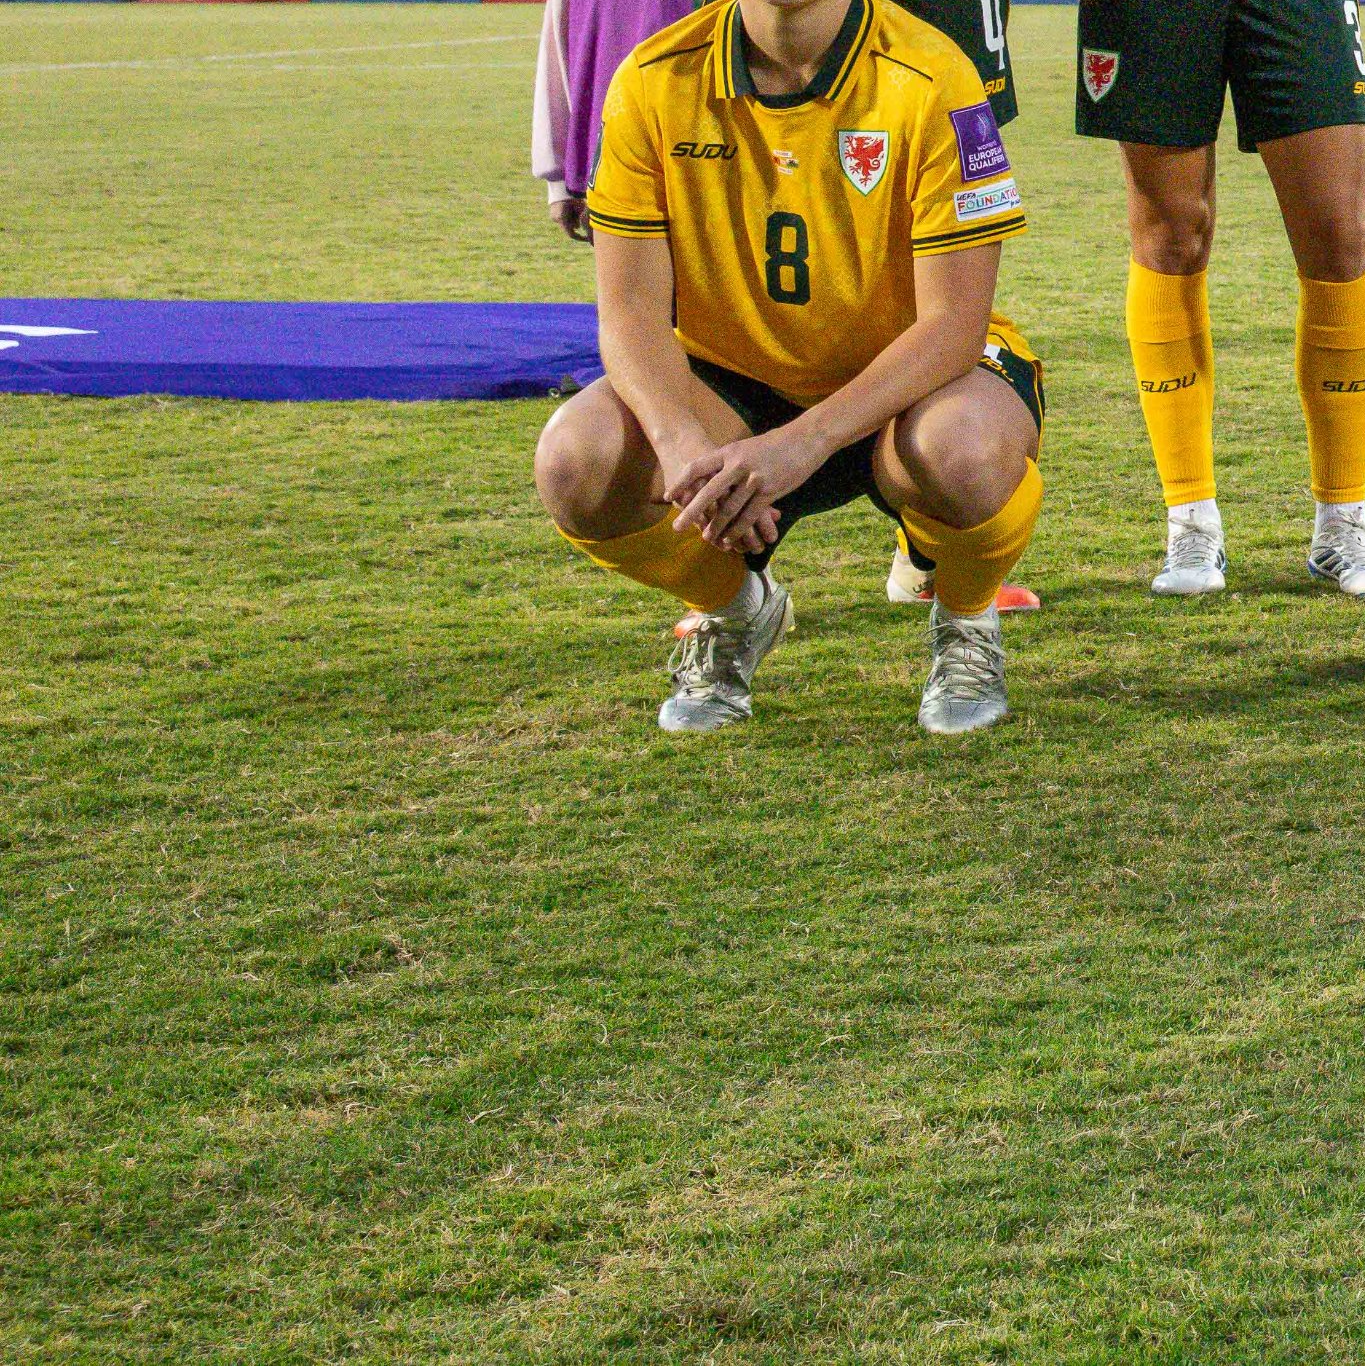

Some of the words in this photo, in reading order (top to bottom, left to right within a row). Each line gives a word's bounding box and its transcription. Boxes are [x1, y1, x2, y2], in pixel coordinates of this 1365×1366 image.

[670, 141, 738, 160] SUDU
[764, 211, 811, 306] 8
[1140, 371, 1197, 394] SUDU
